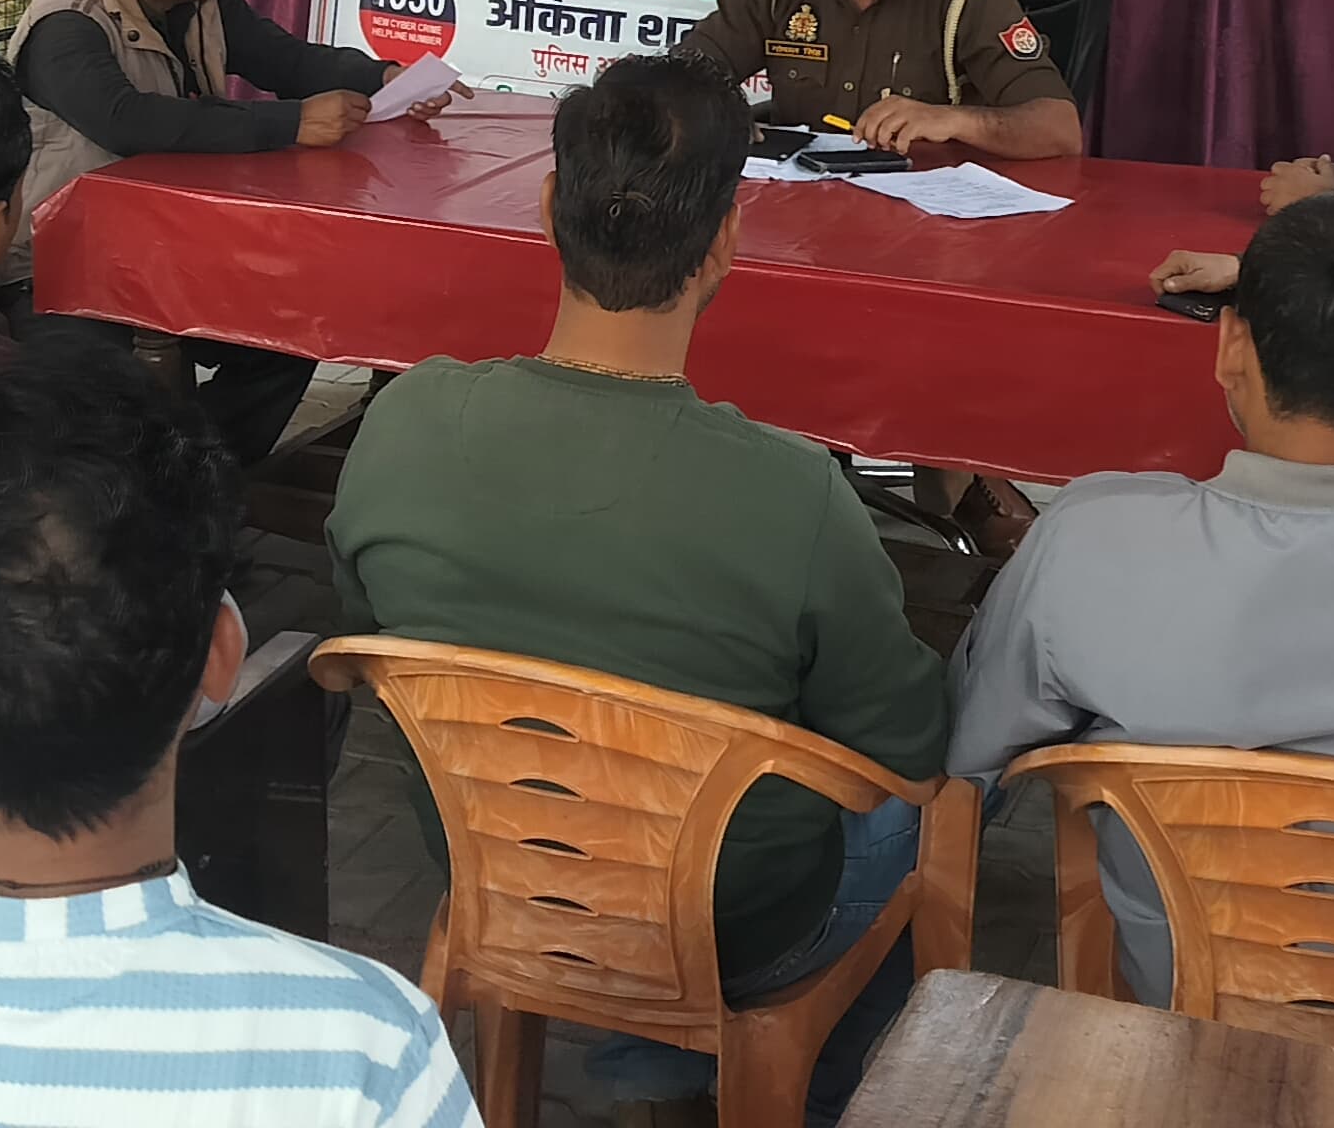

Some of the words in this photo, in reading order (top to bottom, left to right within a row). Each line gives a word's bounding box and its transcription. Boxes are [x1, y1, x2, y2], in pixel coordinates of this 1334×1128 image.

[372, 16, 389, 27] NEW
[390, 18, 417, 31] CYBER
[418, 22, 442, 35] CRIME
[371, 28, 407, 42] HELPLINE
[408, 32, 442, 46] NUMBER
[532, 45, 589, 76] पुलिस
